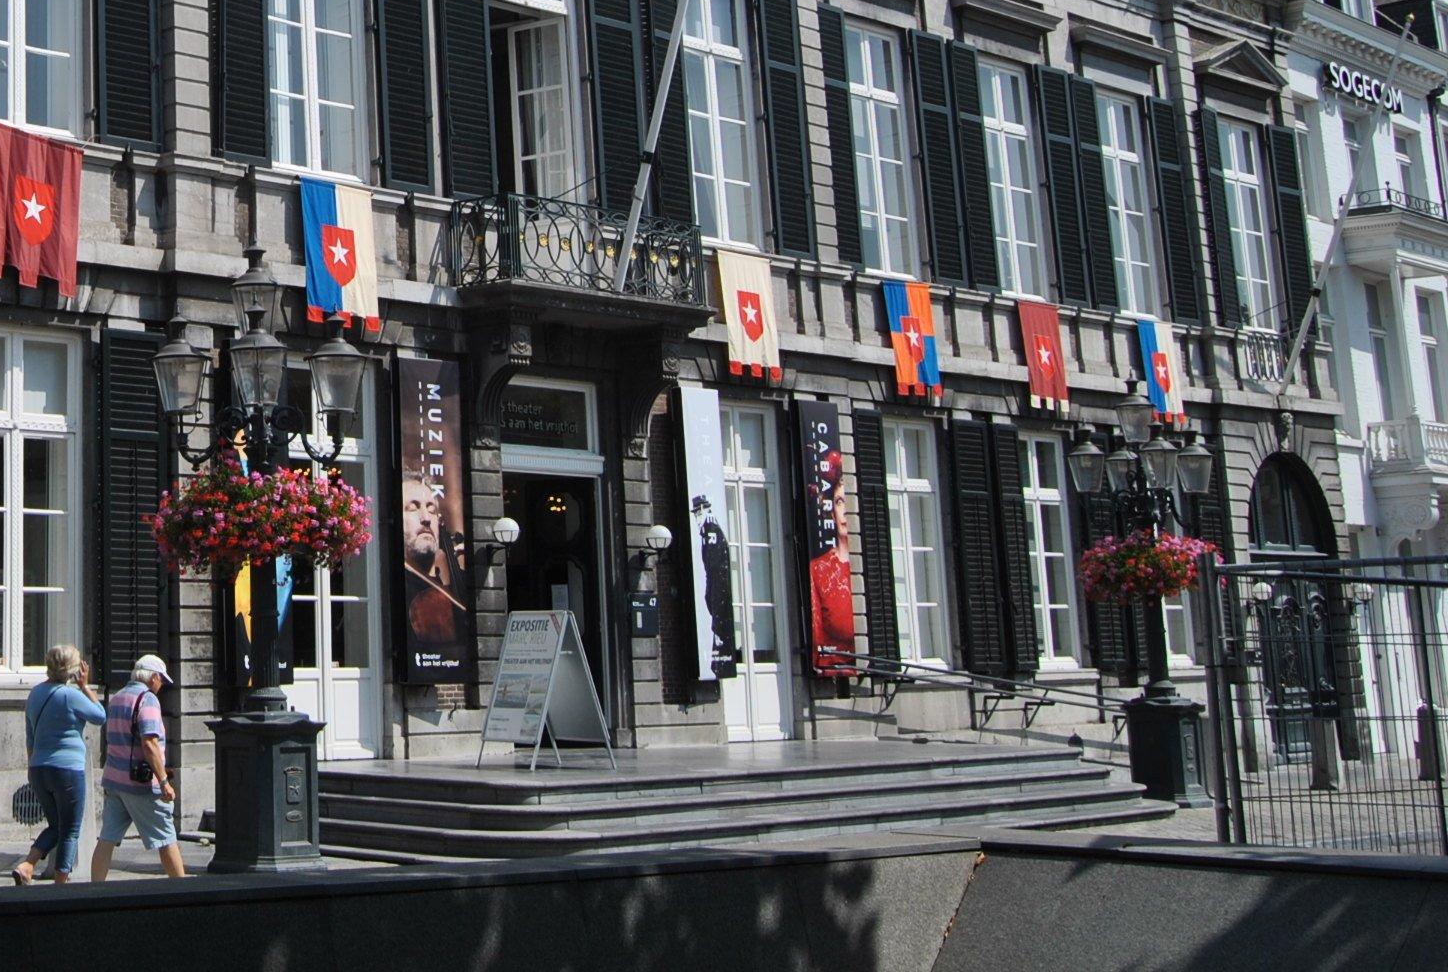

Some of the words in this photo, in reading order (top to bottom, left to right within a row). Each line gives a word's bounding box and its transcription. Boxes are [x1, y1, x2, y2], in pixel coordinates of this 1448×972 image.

[507, 400, 543, 414] theater
[508, 418, 526, 429] aan
[528, 417, 544, 431] het
[427, 383, 445, 499] MUZIEK
[817, 422, 836, 548] CABARET
[510, 619, 550, 632] EXPOSITIE
